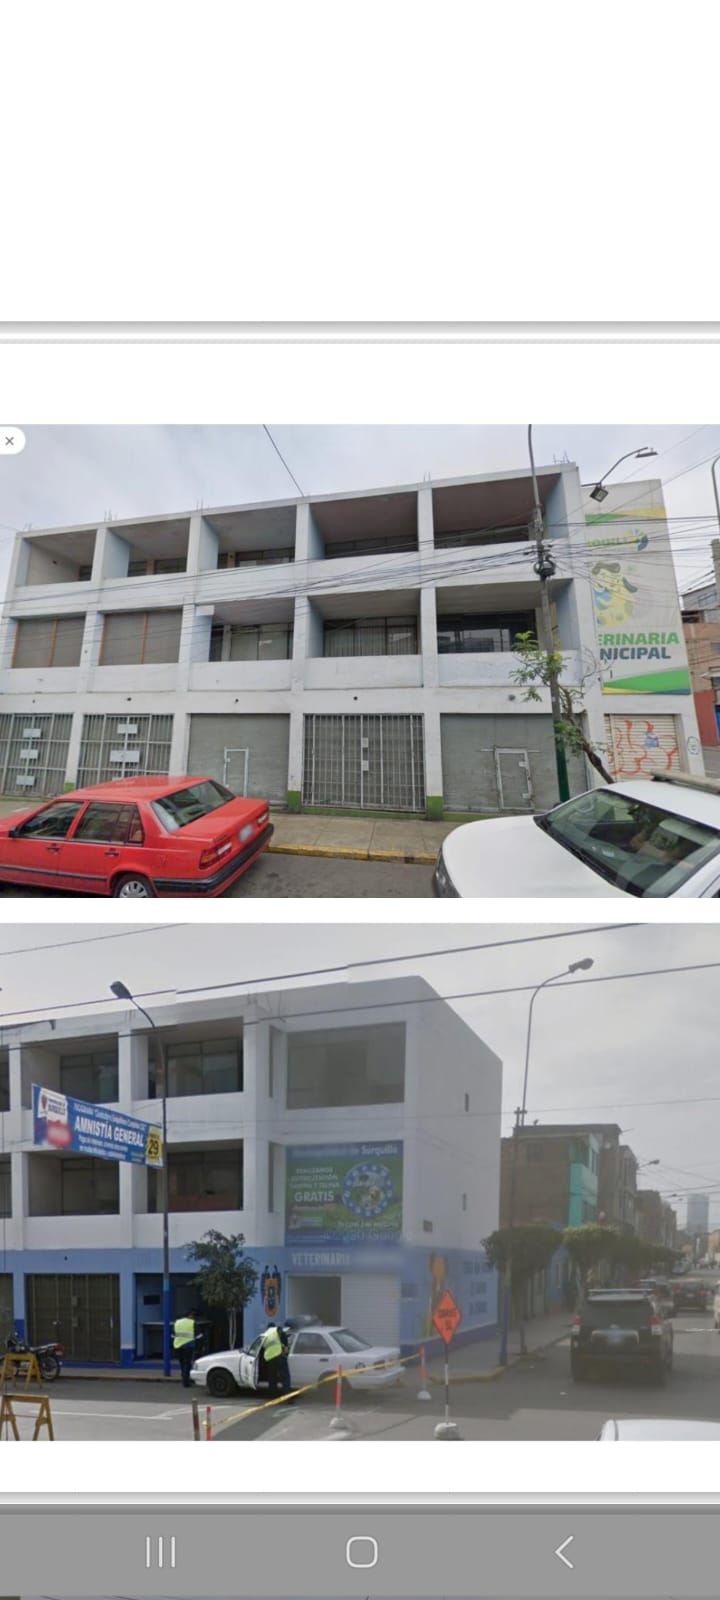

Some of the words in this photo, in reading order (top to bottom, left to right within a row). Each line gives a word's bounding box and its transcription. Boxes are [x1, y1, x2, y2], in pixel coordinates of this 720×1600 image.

[600, 646, 671, 661] NICIPAL
[75, 1115, 112, 1139] AMNISTÍA
[113, 1126, 144, 1147] GENERAL
[148, 1139, 159, 1152] 29
[294, 1190, 335, 1203] GRATIS
